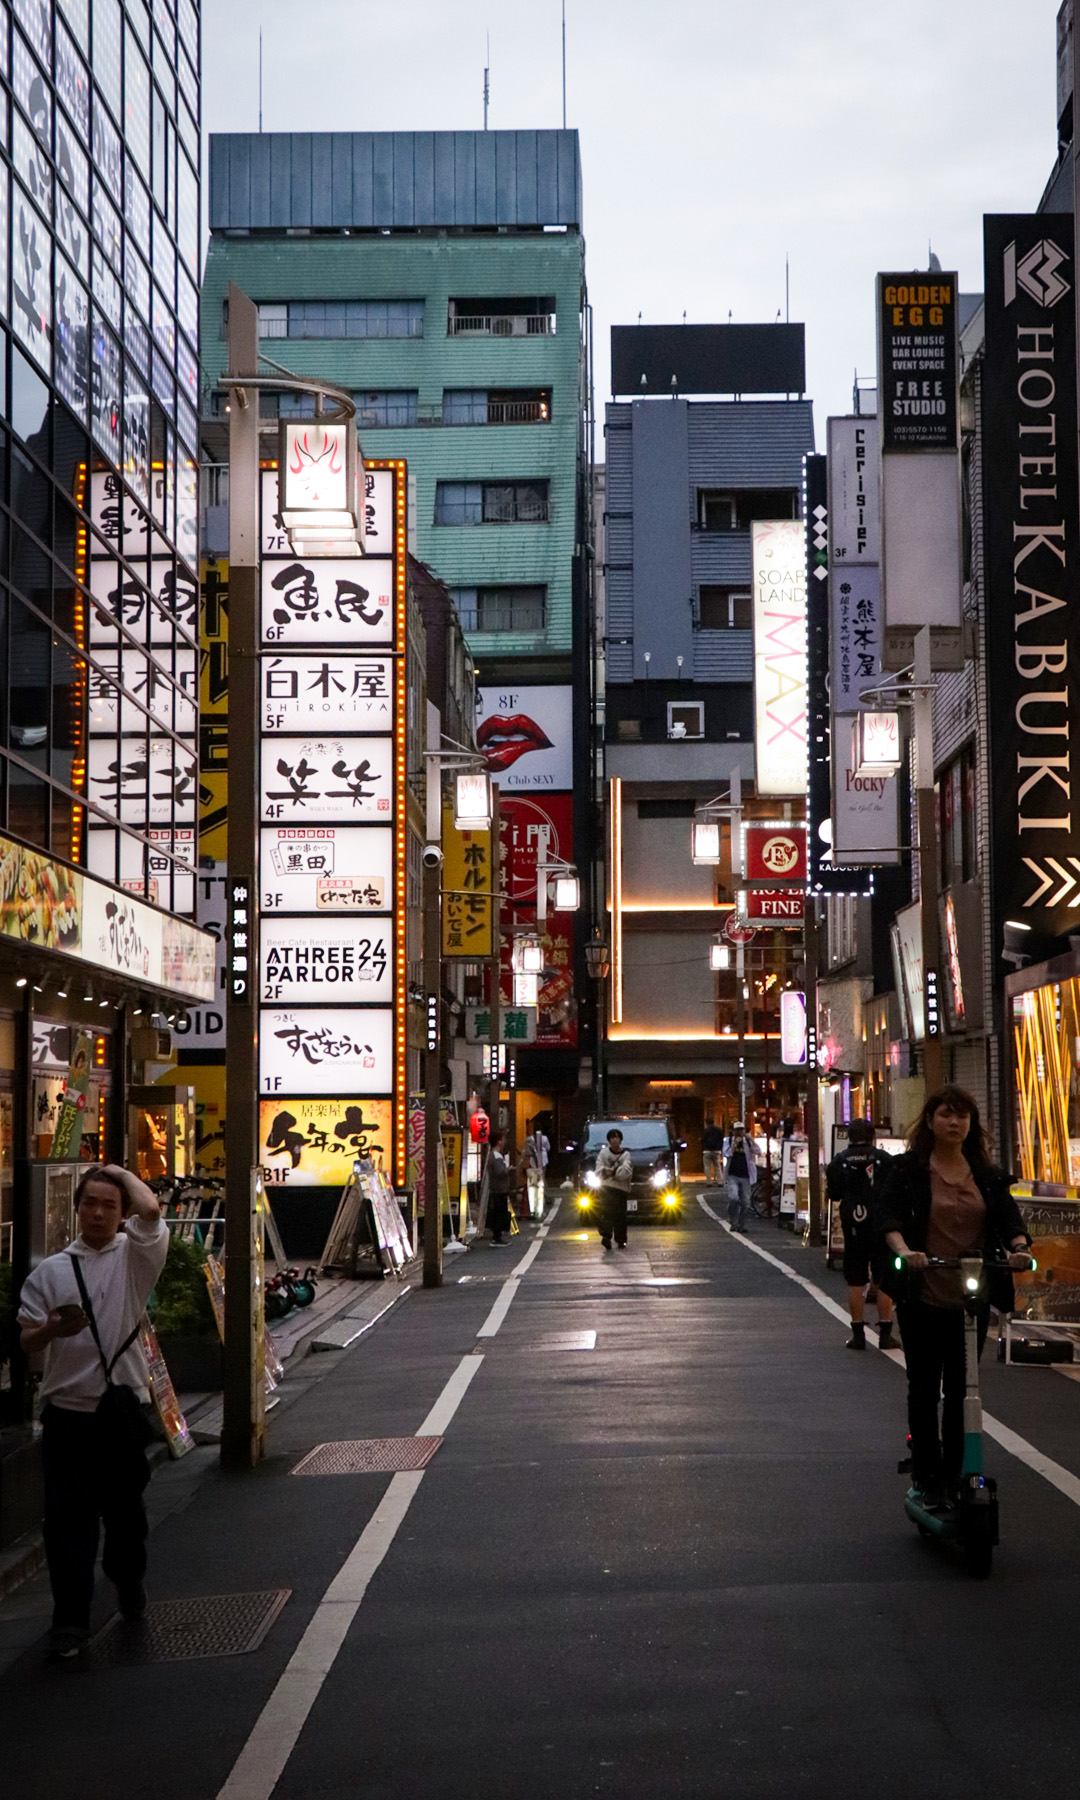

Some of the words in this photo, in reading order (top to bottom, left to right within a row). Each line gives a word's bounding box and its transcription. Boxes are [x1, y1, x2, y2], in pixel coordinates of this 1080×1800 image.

[885, 286, 951, 305] GOLDEN
[893, 307, 943, 326] EGG
[892, 336, 911, 346] LIVE
[914, 336, 945, 346] MUSIC
[893, 348, 910, 358] BAR
[912, 348, 945, 358] LOUNGE
[893, 360, 917, 370] EVENT
[919, 360, 945, 370] SPACE
[896, 381, 943, 397] FREE
[893, 400, 946, 415] STUDIO
[1016, 323, 1057, 510] HOTEL
[855, 429, 867, 554] Cerisier
[267, 537, 285, 550] 7F
[835, 548, 847, 558] 3F
[759, 570, 804, 585] SOAP
[271, 563, 384, 626] 魚民
[760, 587, 805, 602] LAND
[266, 626, 285, 640] 6F
[852, 599, 877, 677] 熊本屋
[266, 658, 390, 699] 白木屋
[763, 611, 807, 746] MAX
[1013, 518, 1071, 836] KABUKI
[498, 694, 519, 709] 8F
[266, 714, 285, 728] 5F
[265, 758, 382, 807] 笑笑
[507, 774, 531, 785] Club
[533, 774, 555, 785] SEXY
[845, 768, 887, 799] Pocky
[265, 804, 284, 818] 4F
[287, 853, 326, 871] 黒田
[464, 843, 486, 938] ホルモン
[264, 893, 283, 907] 3F
[760, 900, 801, 914] FINE
[446, 892, 463, 947] おいで屋
[233, 886, 248, 995] 仲見世通り
[266, 947, 355, 963] ATHREE
[266, 965, 354, 982] PARLOR
[264, 985, 283, 999] 2F
[273, 1013, 297, 1023] つきじ
[274, 1024, 373, 1065] すしざむらい
[264, 1077, 282, 1091] 1F
[302, 1104, 342, 1118] 居楽屋
[266, 1105, 384, 1170] 千年の宴
[263, 1167, 290, 1182] B1F
